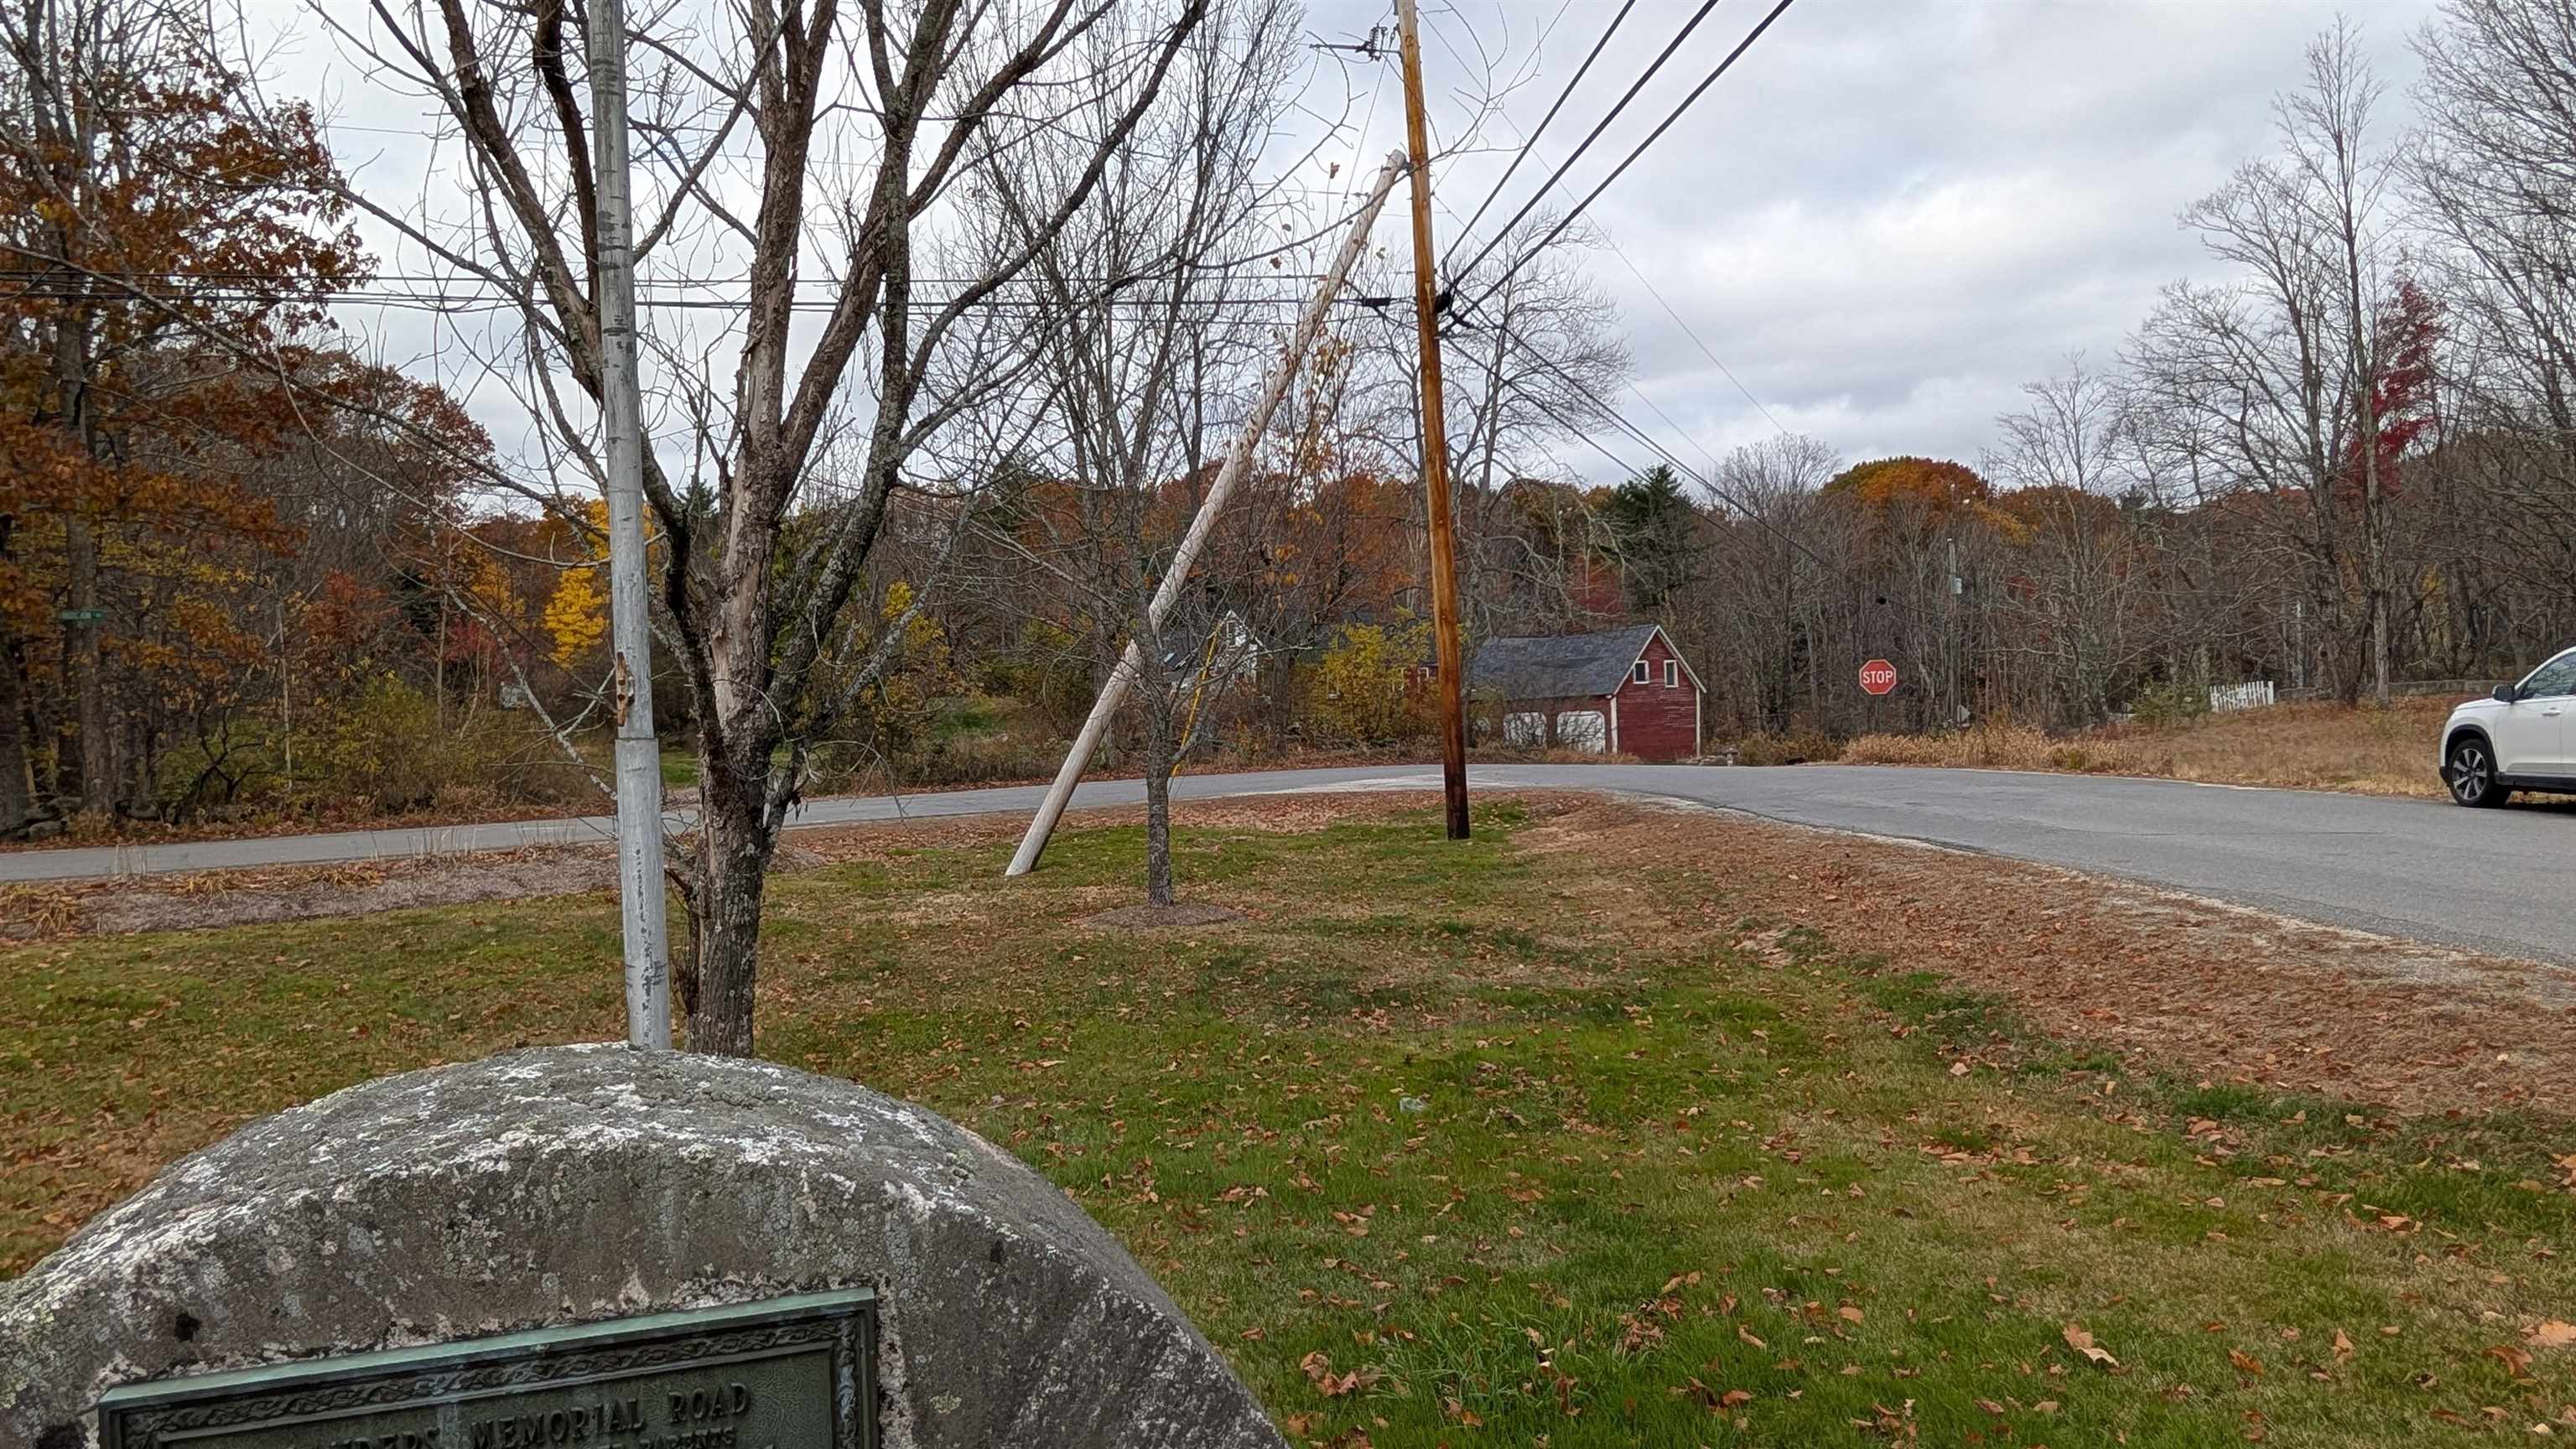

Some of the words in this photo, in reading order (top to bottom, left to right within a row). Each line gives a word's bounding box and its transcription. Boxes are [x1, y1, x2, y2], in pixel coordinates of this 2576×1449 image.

[1862, 671, 1893, 684] STOP
[469, 1397, 647, 1449] MEMORIAL
[667, 1382, 749, 1424] ROAD
